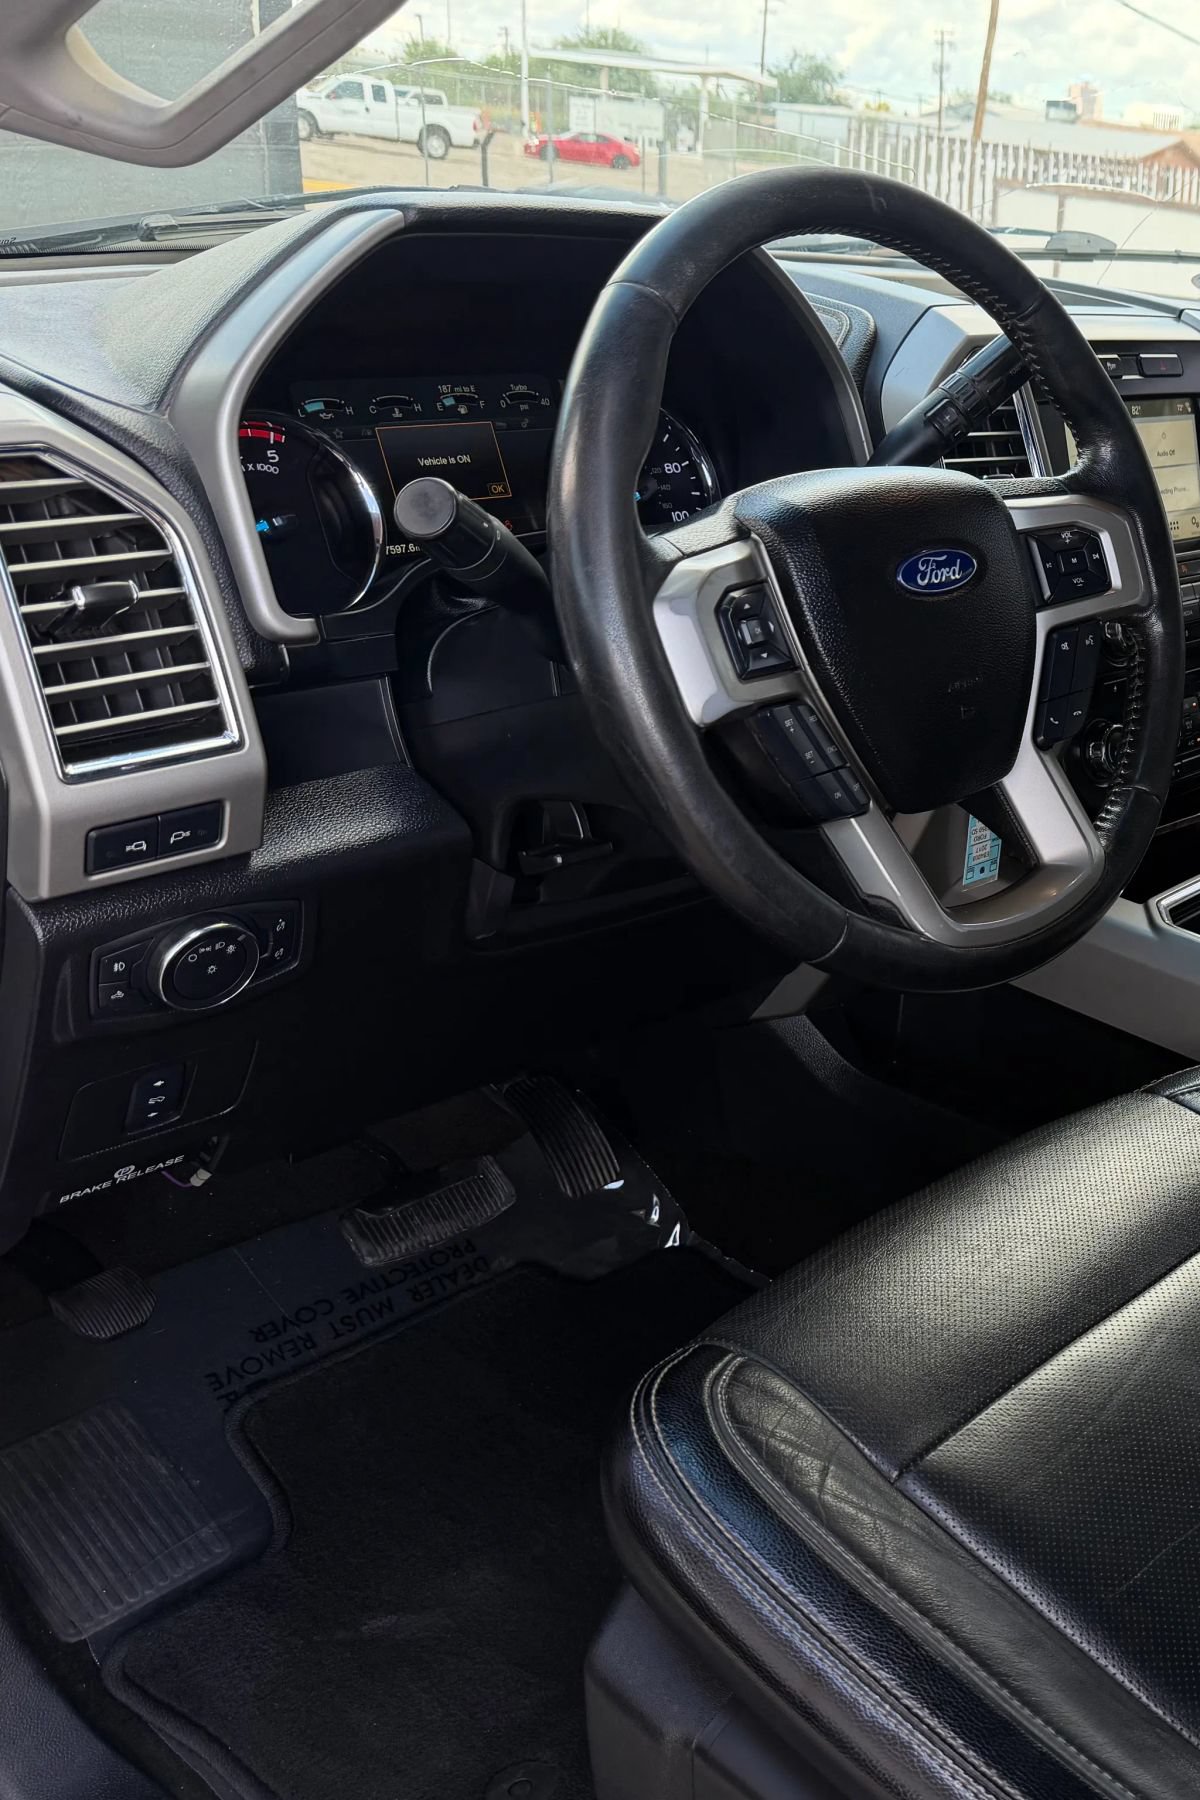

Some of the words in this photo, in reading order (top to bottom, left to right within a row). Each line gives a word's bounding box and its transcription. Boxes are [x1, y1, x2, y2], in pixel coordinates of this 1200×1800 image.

[438, 384, 452, 393] 187
[510, 383, 528, 391] Turbo
[345, 405, 354, 416] H
[368, 405, 377, 414] C
[413, 402, 422, 412] H
[436, 402, 444, 412] E
[266, 449, 280, 463] 5
[417, 455, 447, 467] Vehicle
[449, 456, 456, 465] is
[456, 454, 472, 464] ON
[256, 463, 280, 475] 1000
[663, 462, 681, 474] 80
[491, 484, 505, 494] OK
[671, 510, 689, 523] 100
[917, 554, 962, 587] Ford
[59, 1179, 113, 1204] BRAKE
[115, 1154, 185, 1185] RELEASE
[340, 1239, 477, 1305] PROTECTIVE
[406, 1256, 490, 1302] DEALER
[248, 1299, 334, 1343] COVER
[328, 1296, 394, 1340] MUST
[204, 1332, 317, 1392] REMOVE
